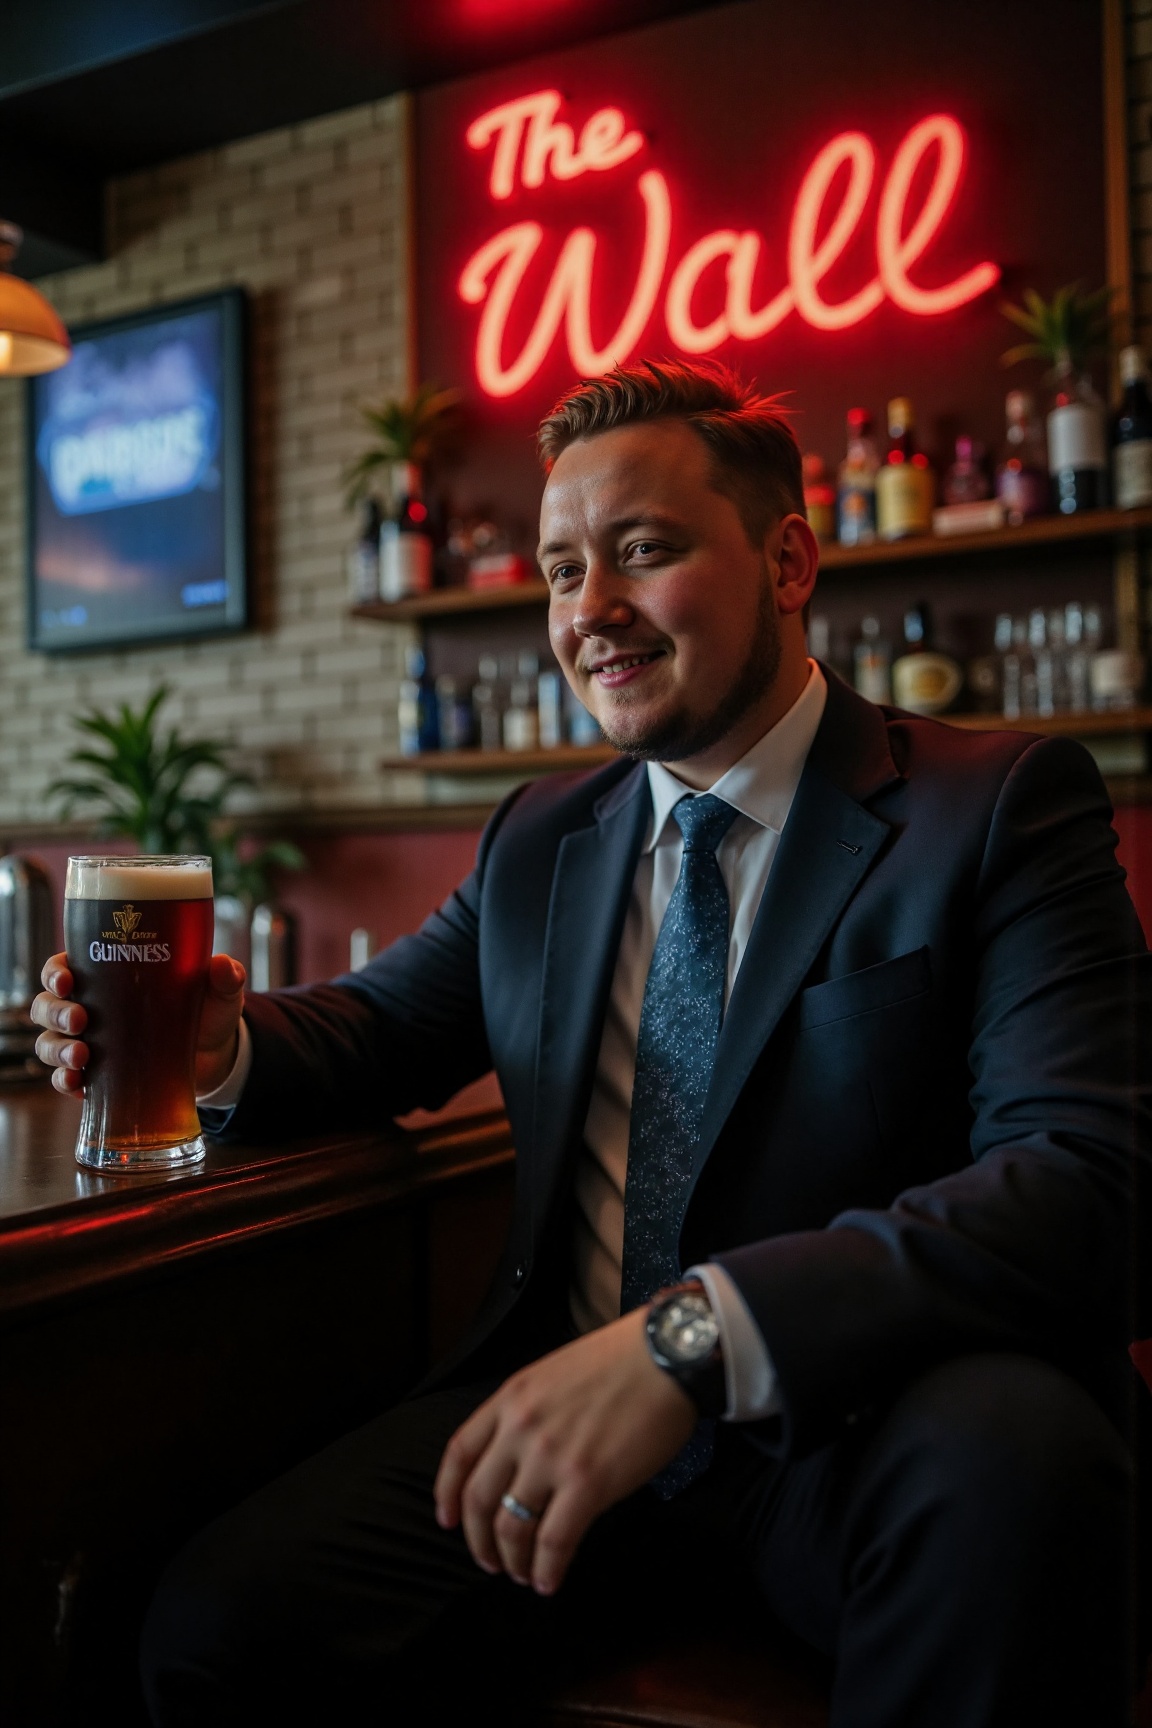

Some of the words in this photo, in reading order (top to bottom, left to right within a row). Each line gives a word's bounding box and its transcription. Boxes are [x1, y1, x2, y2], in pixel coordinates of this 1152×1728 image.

[466, 88, 644, 200] The
[459, 114, 1000, 398] Wall
[89, 941, 171, 963] GUINNESS
